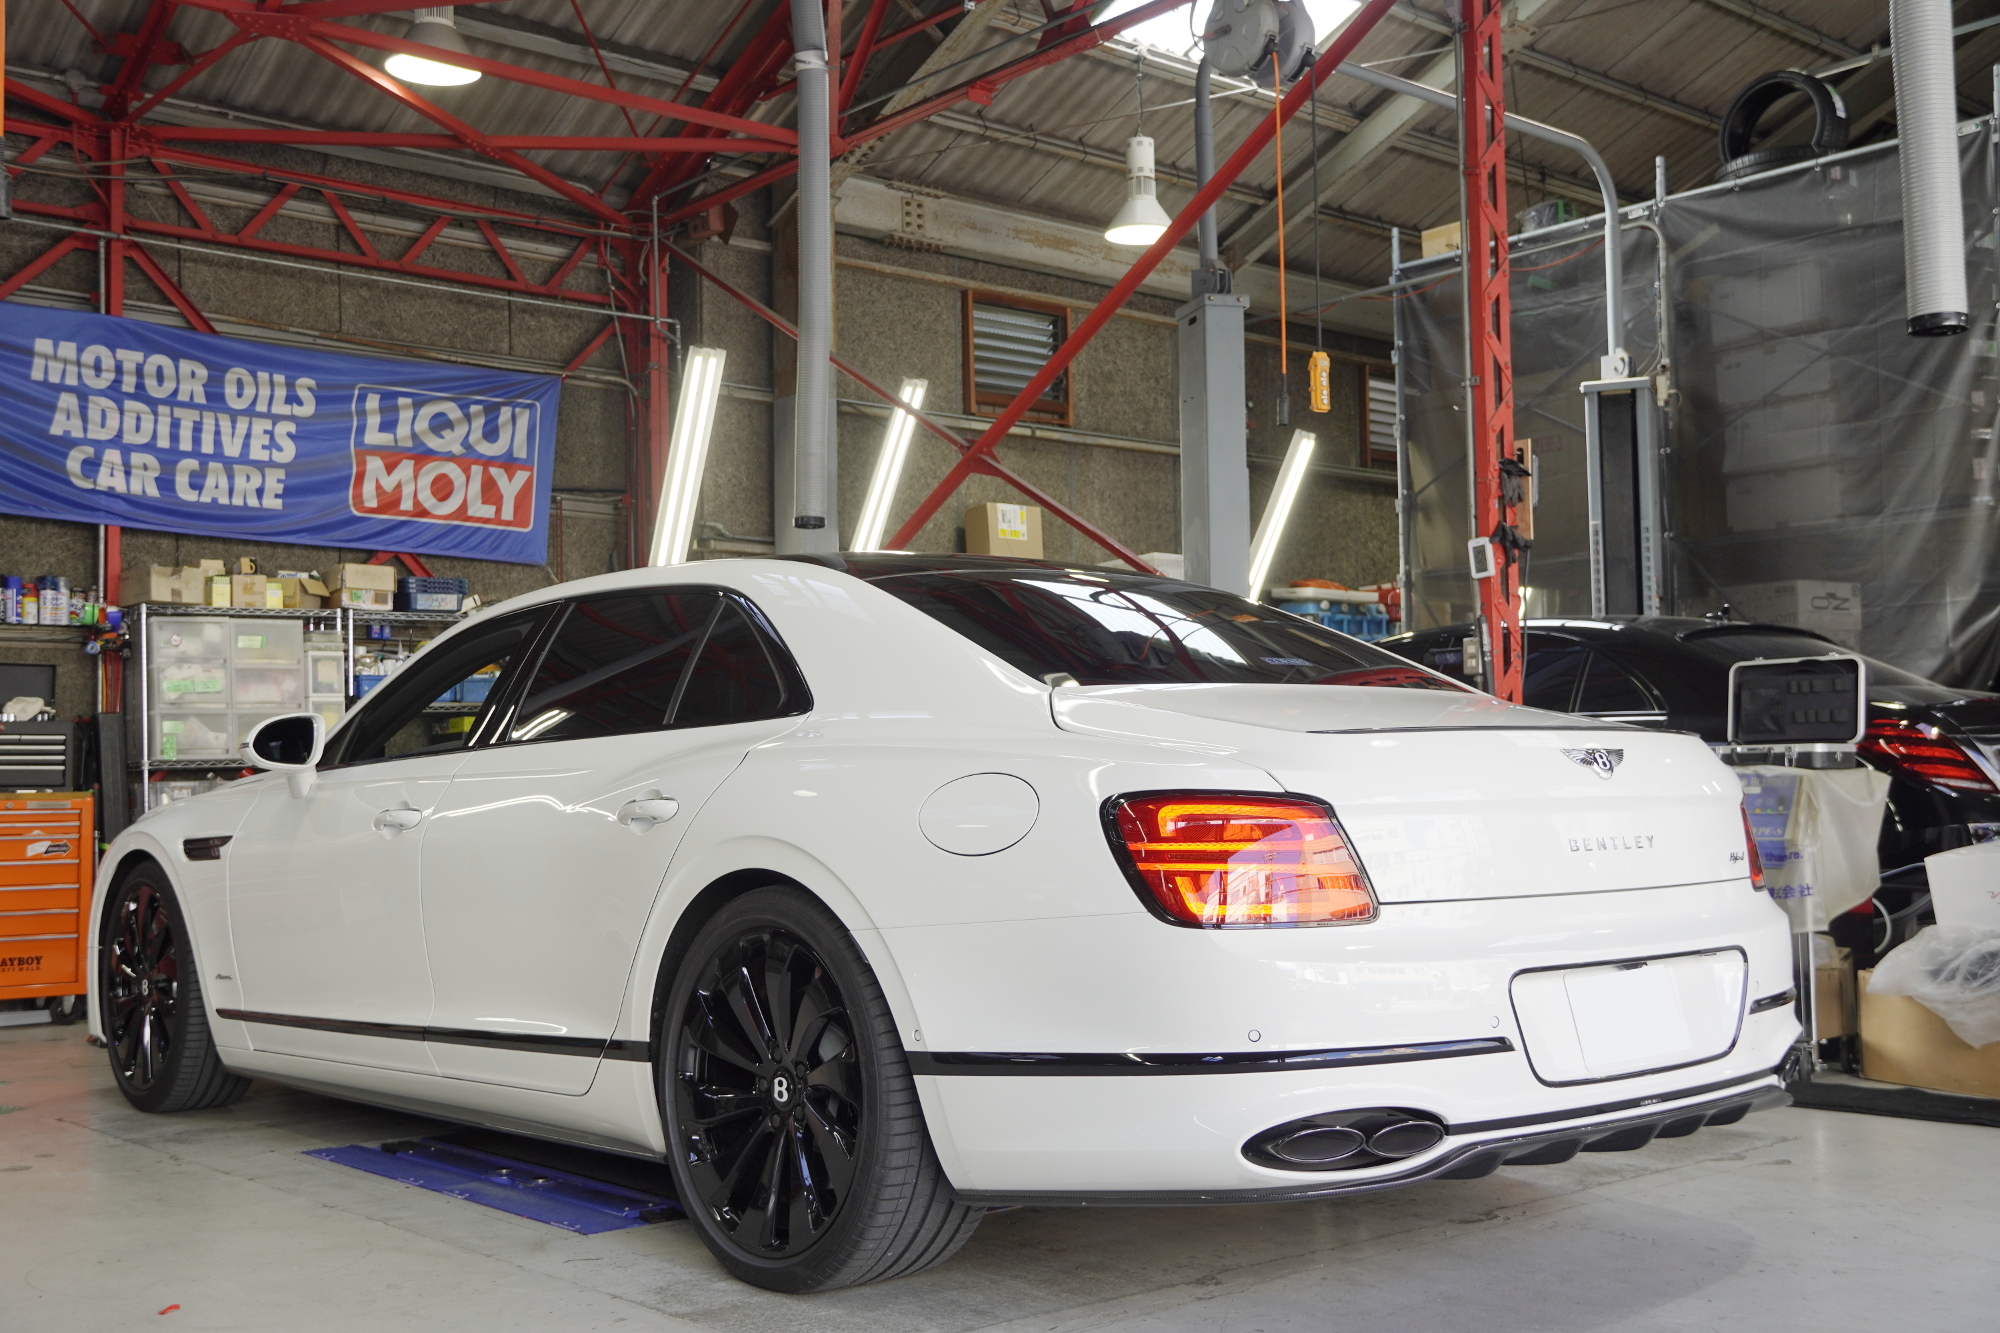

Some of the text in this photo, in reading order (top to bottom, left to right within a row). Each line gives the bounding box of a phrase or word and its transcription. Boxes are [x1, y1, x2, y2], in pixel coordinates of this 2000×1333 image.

[31, 338, 317, 418] MOTOR OILS
[50, 391, 296, 463] ADDITIVES
[364, 393, 530, 459] LIQUI
[66, 445, 286, 510] CAR CARE
[362, 455, 532, 521] MOLY
[1569, 835, 1655, 852] BENTLEY
[1752, 826, 1784, 836] YPE-S
[773, 1076, 788, 1102] B
